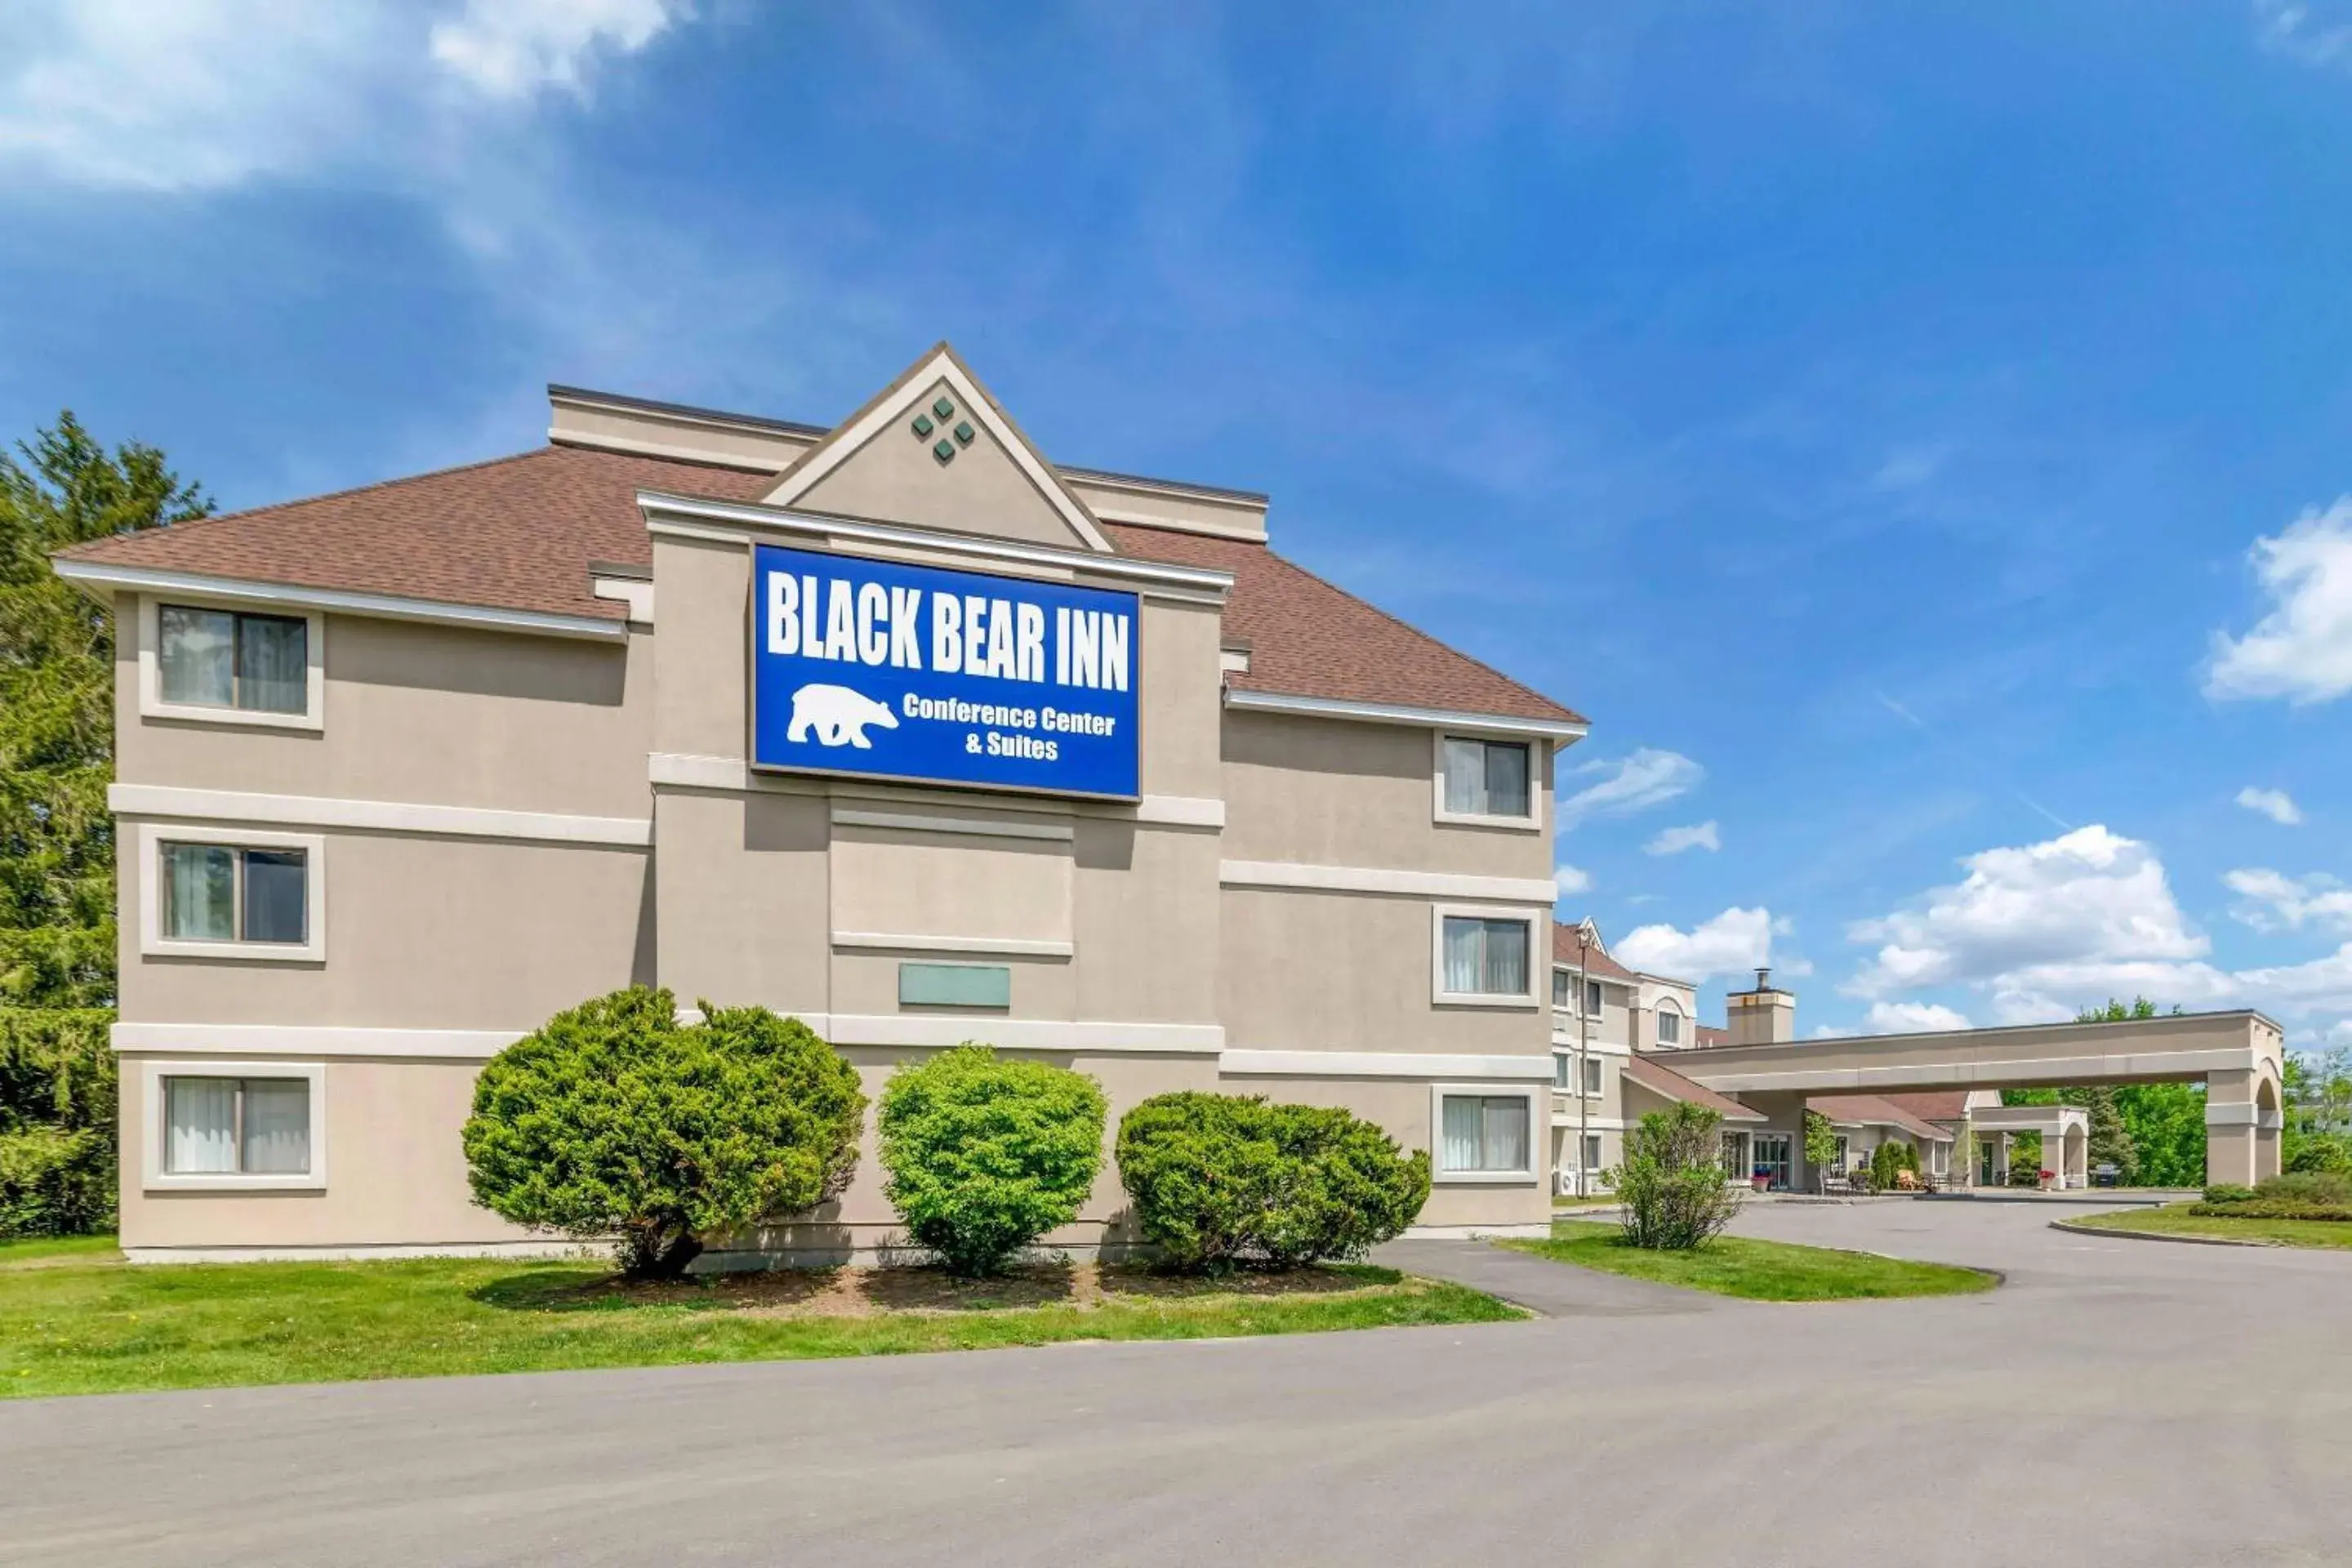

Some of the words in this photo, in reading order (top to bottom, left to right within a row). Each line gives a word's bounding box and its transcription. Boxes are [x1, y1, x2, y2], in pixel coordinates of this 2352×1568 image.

[767, 570, 922, 670] BLACK
[932, 591, 1045, 684] BEAR
[1055, 607, 1129, 693] INN
[902, 693, 1037, 729] Conference
[1040, 706, 1116, 737] Center
[965, 733, 983, 755] &
[987, 732, 1058, 761] Suites
